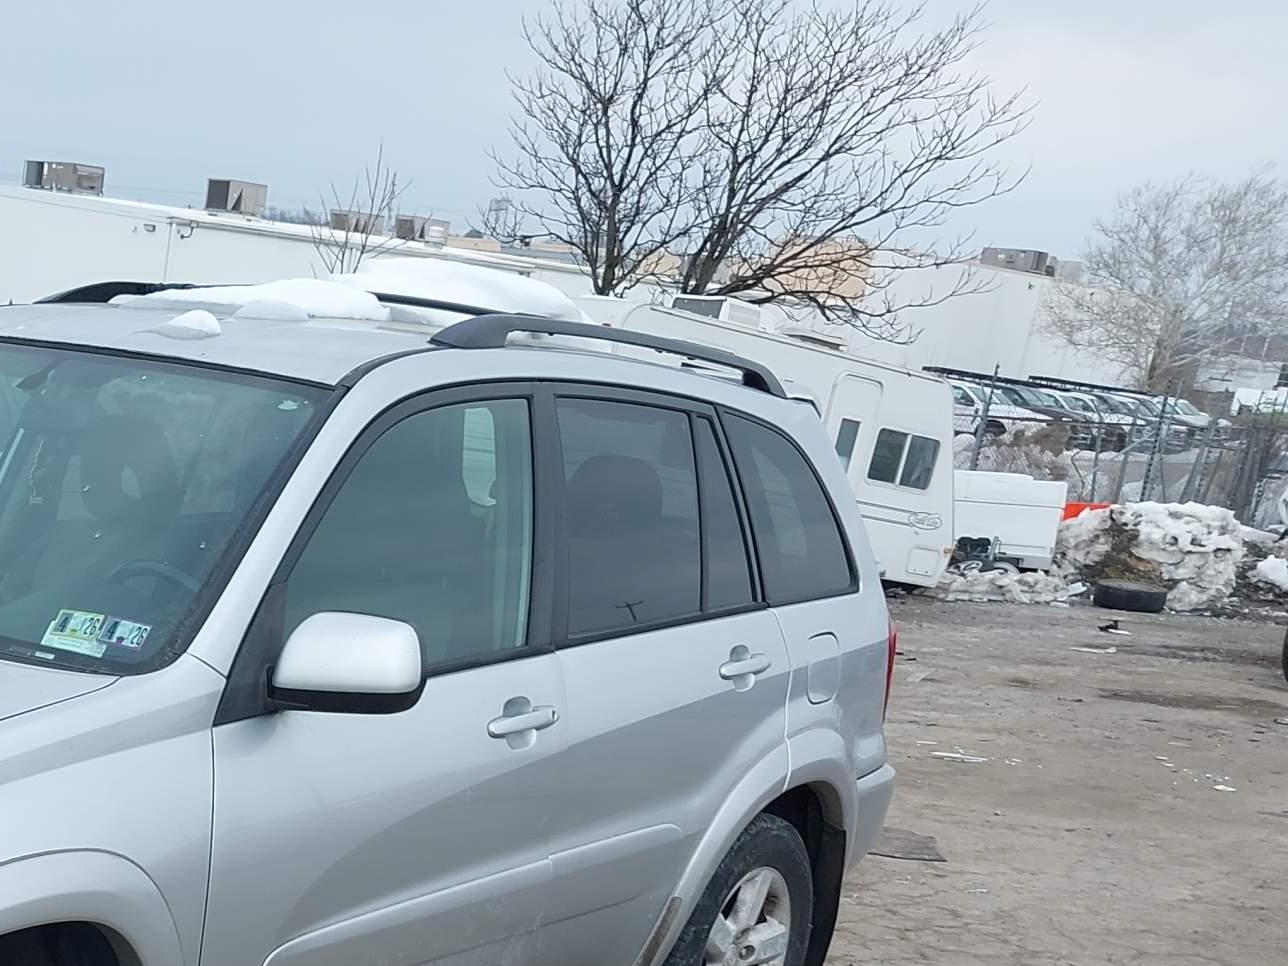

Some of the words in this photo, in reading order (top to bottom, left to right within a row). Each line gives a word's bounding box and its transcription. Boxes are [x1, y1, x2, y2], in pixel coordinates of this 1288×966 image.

[84, 617, 100, 635] 26
[107, 620, 119, 640] 4
[130, 626, 148, 646] 26
